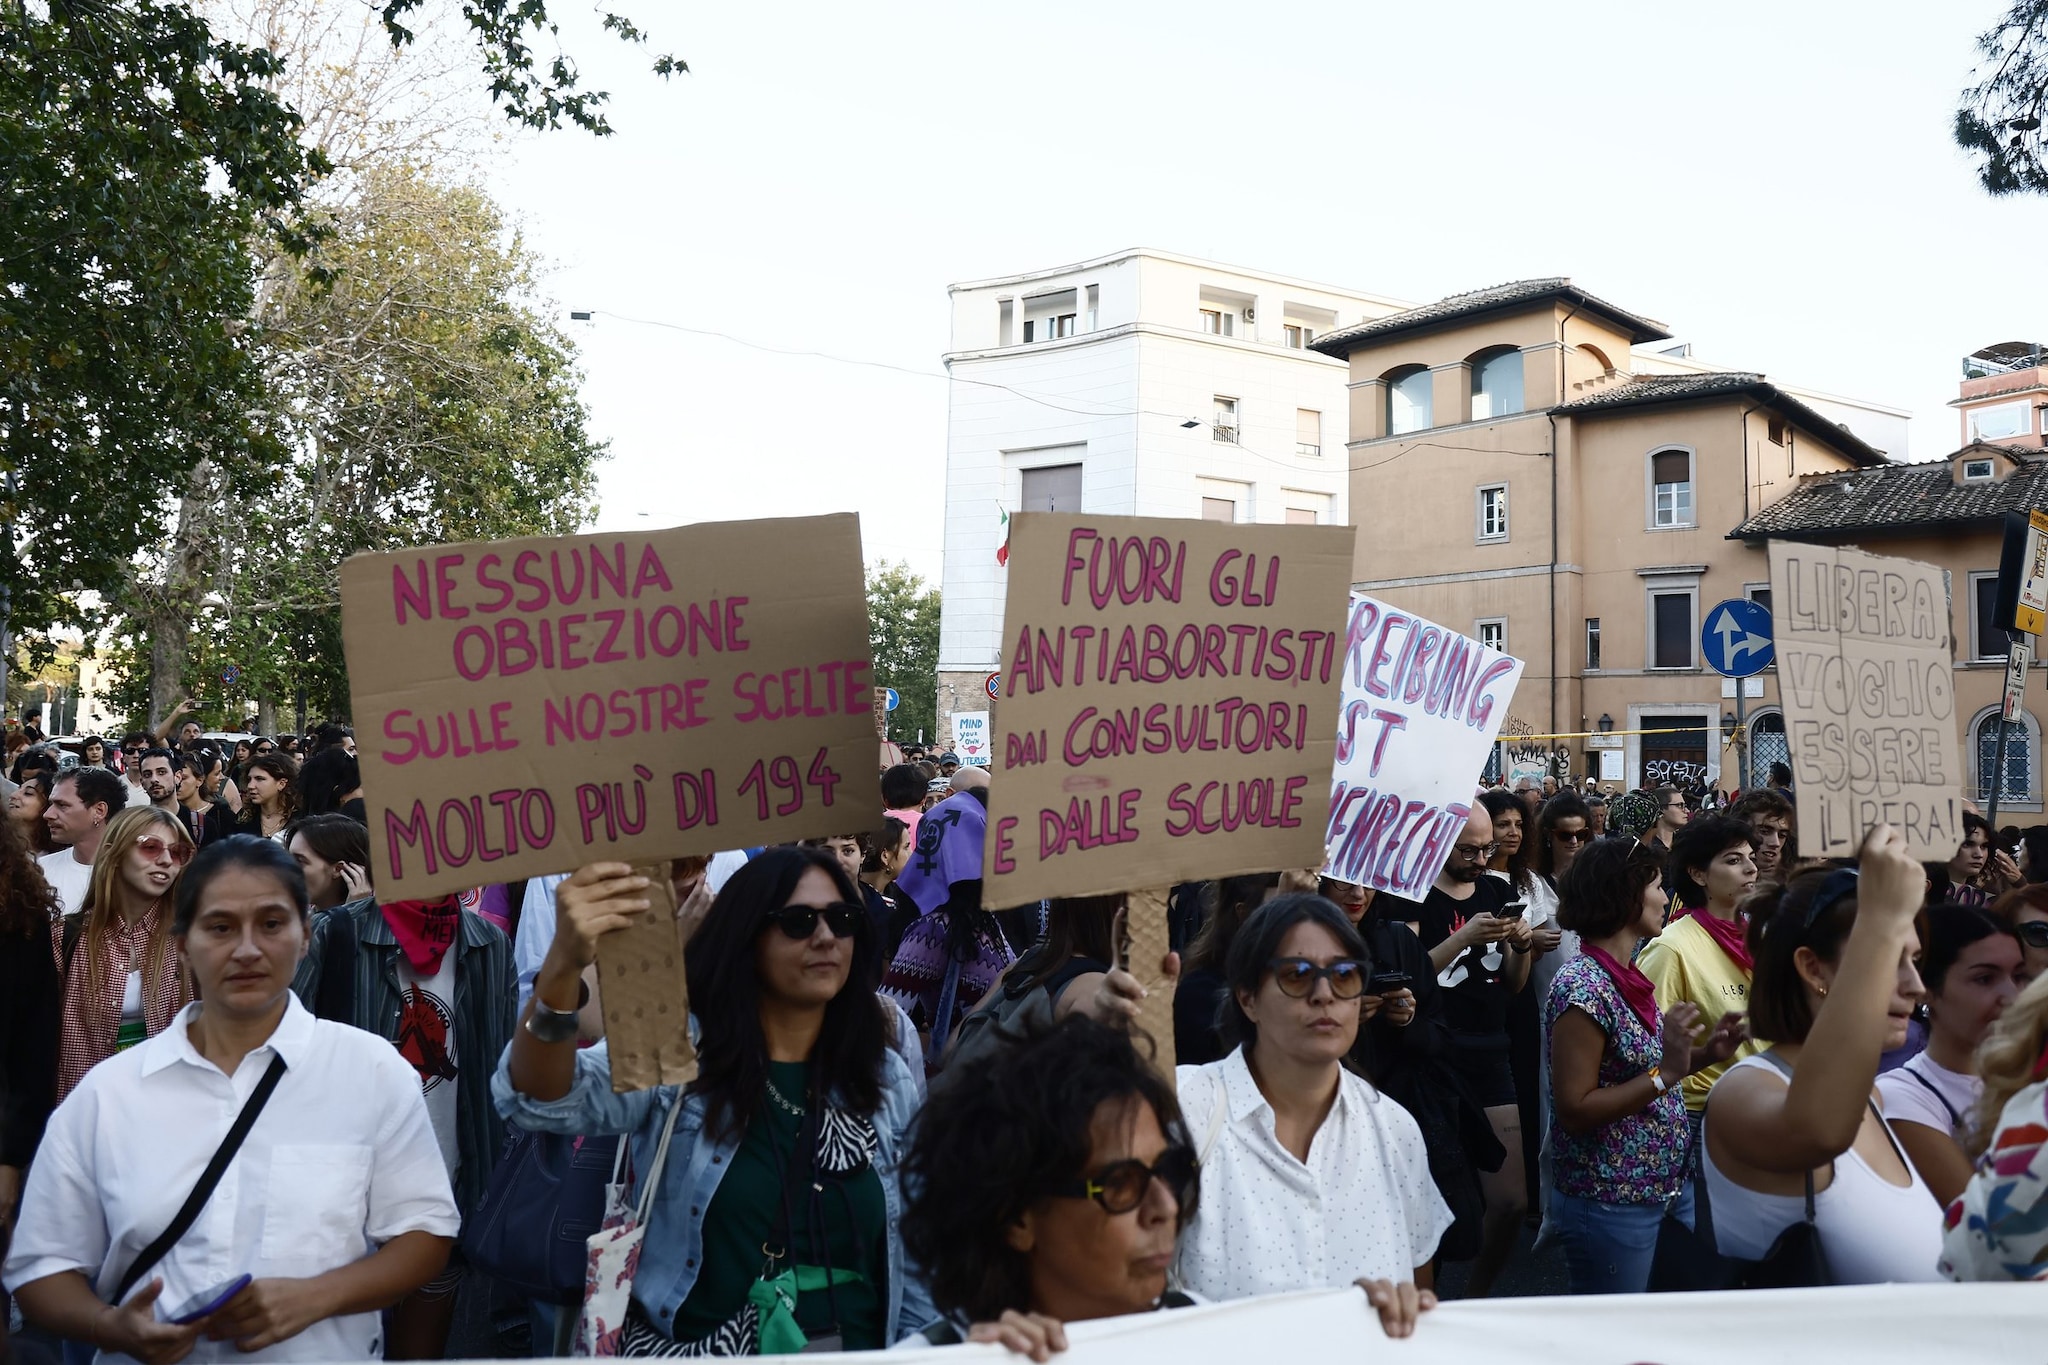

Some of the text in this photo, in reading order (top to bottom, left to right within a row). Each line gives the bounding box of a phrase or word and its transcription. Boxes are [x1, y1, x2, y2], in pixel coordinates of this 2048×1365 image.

[392, 542, 672, 625] NESSUNA
[1062, 527, 1279, 610] FUORI GLI
[1787, 558, 1948, 650] LIBERA,
[453, 596, 750, 681] OBIEZIONE
[1006, 624, 1335, 697] ANTIABORTISTI
[1341, 597, 1516, 732] REIBUNG
[382, 702, 519, 765] SULLE
[545, 679, 710, 746] NOSTRE
[733, 661, 873, 723] SCELTE
[960, 719, 982, 729] MIND
[1787, 652, 1953, 721] VOGLIO
[1005, 697, 1307, 770] DAI CONSULTORI
[1336, 692, 1408, 778] ST
[1793, 720, 1945, 798] ESSERE
[384, 747, 840, 880] MOLTO PIÙ DI 194
[994, 776, 1308, 874] E DALLE SCUOLE
[1326, 781, 1472, 898] ENRECHT
